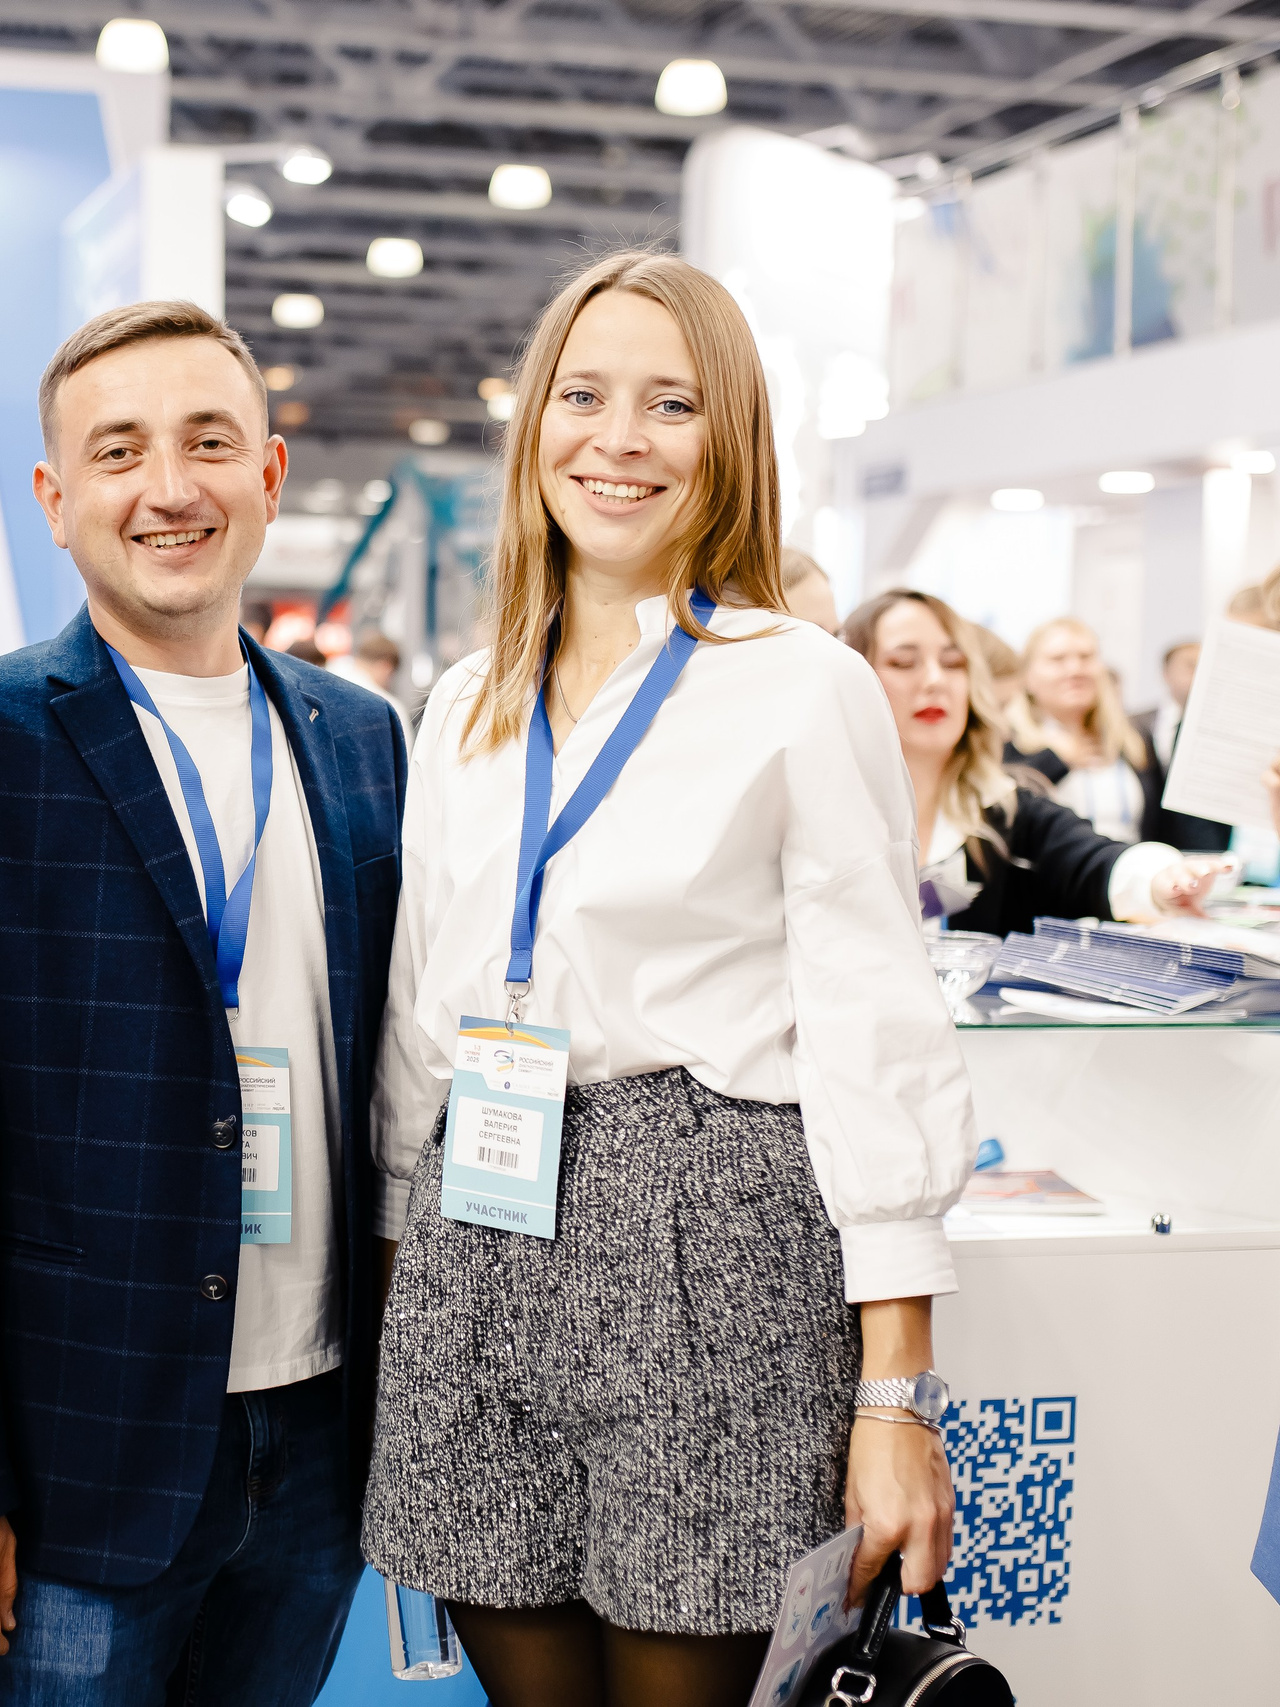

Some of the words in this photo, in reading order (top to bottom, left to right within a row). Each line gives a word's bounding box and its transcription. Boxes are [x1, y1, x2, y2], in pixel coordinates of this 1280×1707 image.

[481, 1106, 523, 1122] ШУМАКОВА
[483, 1119, 518, 1133] ВАЛЕРИЯ
[478, 1130, 521, 1146] СЕРГЕЕВНА
[465, 1200, 528, 1225] УЧАСТНИК
